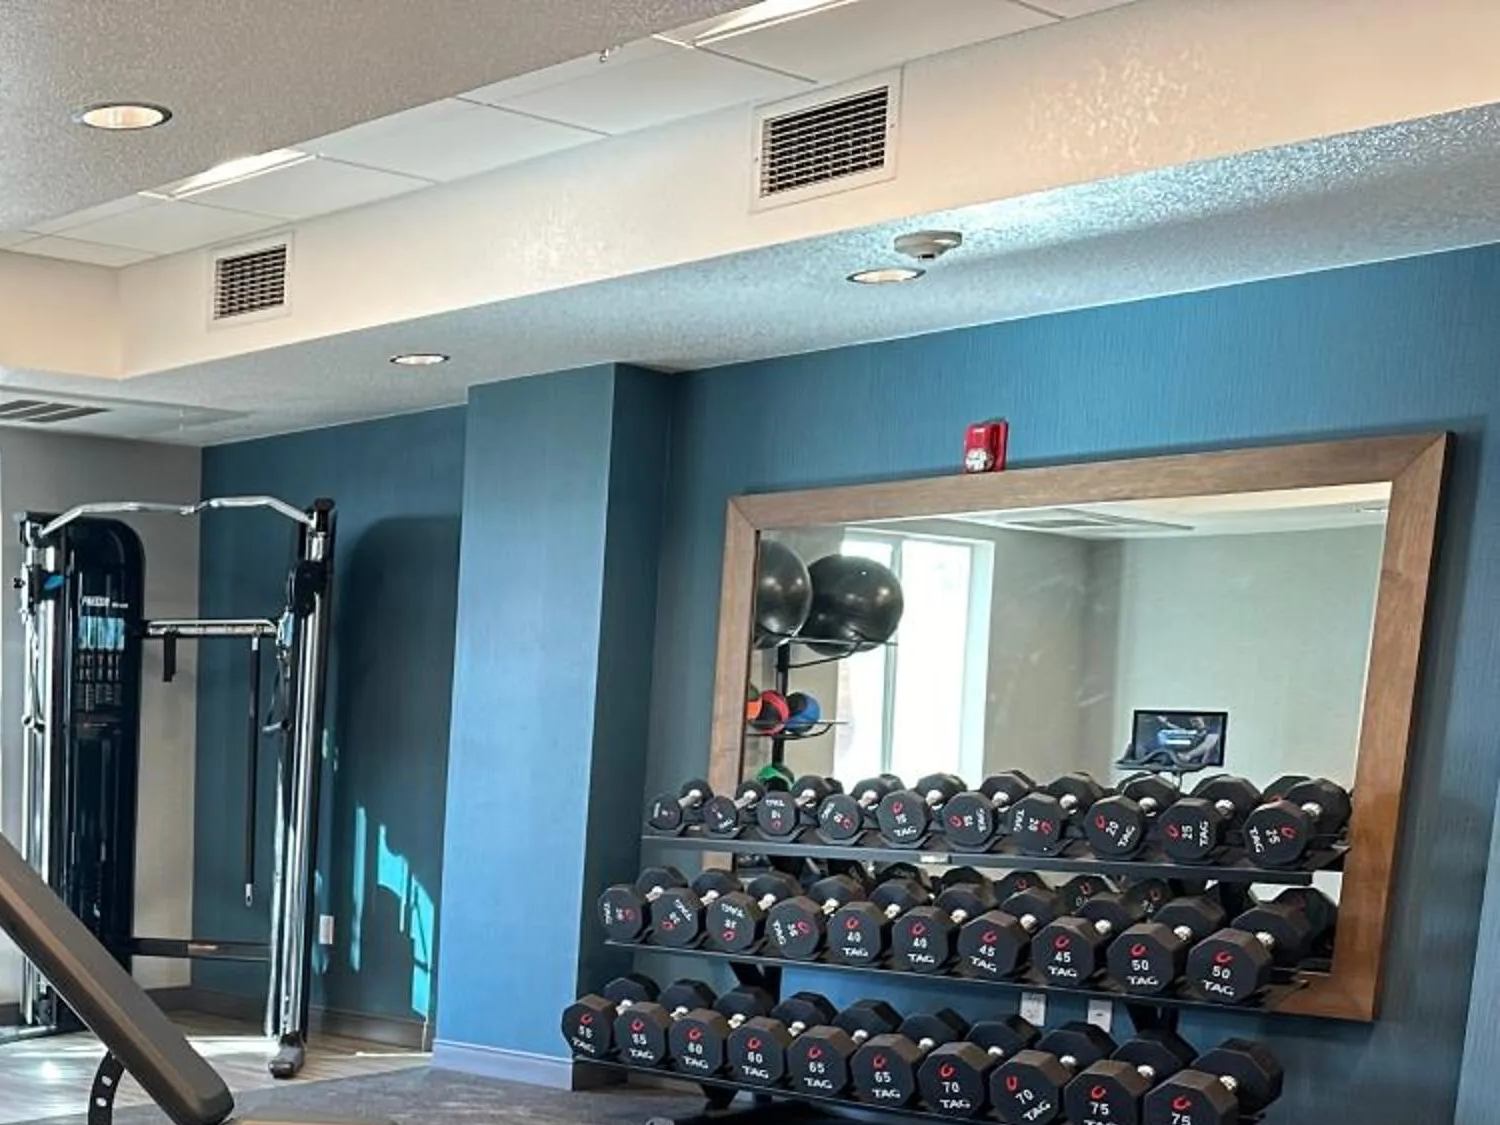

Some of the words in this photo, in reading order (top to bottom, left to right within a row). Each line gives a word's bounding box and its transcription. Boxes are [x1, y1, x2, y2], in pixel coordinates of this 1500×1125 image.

[1013, 809, 1025, 832] TAG
[1116, 825, 1136, 847] TAG
[1181, 825, 1193, 840] 25
[1199, 820, 1209, 847] TAG
[1250, 825, 1265, 853] TAG
[1265, 828, 1280, 845] 25
[842, 947, 869, 957] TAG
[979, 944, 996, 957] 45
[1054, 951, 1072, 963] 45
[907, 953, 935, 964] TAG
[969, 955, 997, 973] TAG
[1131, 959, 1149, 971] 50
[1047, 966, 1077, 977] TAG
[1211, 965, 1231, 979] 50
[1126, 975, 1159, 985] TAG
[1202, 979, 1236, 996] TAG
[571, 1036, 596, 1054] TAG
[628, 1047, 655, 1060] TAG
[682, 1055, 709, 1070] TAG
[808, 1061, 825, 1074] 65
[742, 1065, 770, 1080] TAG
[873, 1071, 892, 1083] 65
[803, 1077, 833, 1089] TAG
[940, 1081, 961, 1093] 70
[871, 1088, 901, 1098] TAG
[1014, 1088, 1035, 1105] 70
[939, 1099, 971, 1109] TAG
[1022, 1100, 1052, 1121] TAG
[1089, 1101, 1110, 1116] 75
